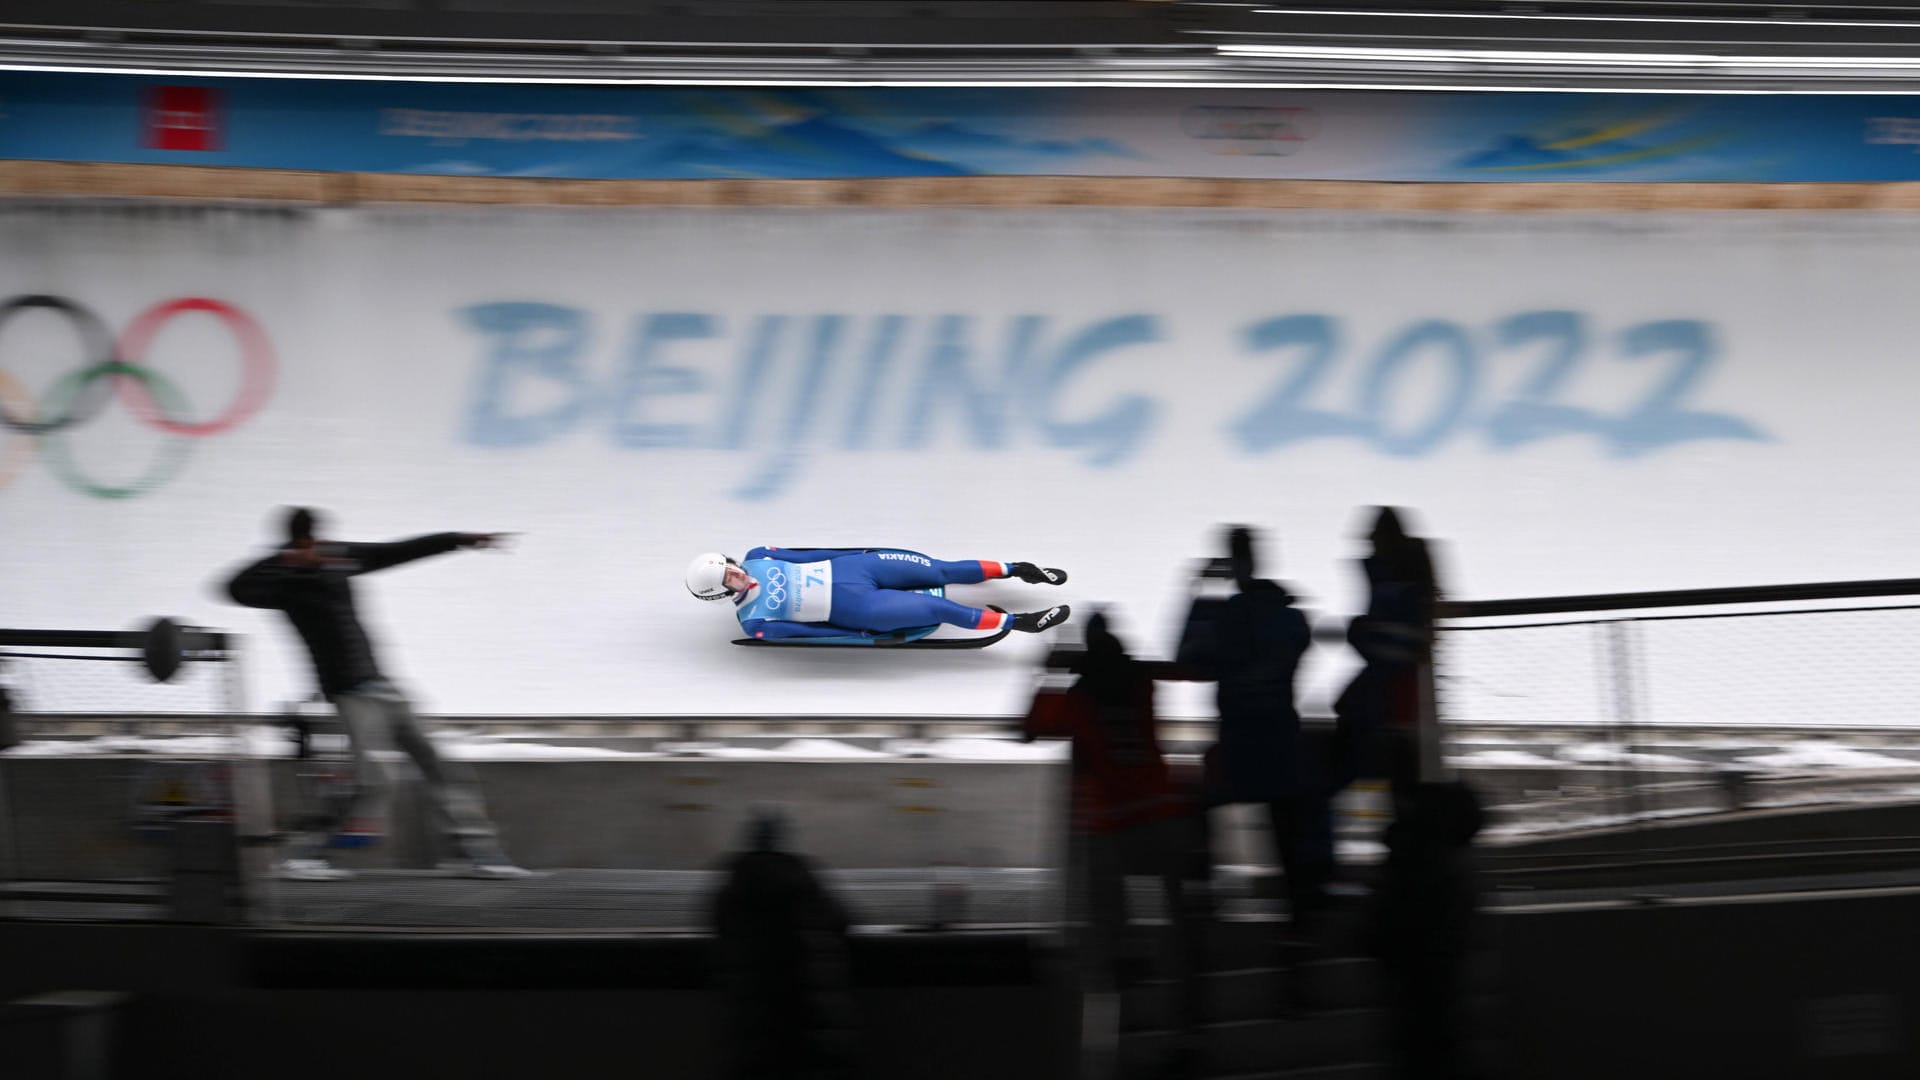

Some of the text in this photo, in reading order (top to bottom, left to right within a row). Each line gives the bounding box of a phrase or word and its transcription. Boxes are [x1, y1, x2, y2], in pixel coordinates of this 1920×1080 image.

[456, 300, 1774, 503] BEIJING 2022
[878, 553, 931, 567] SLOVAKIA
